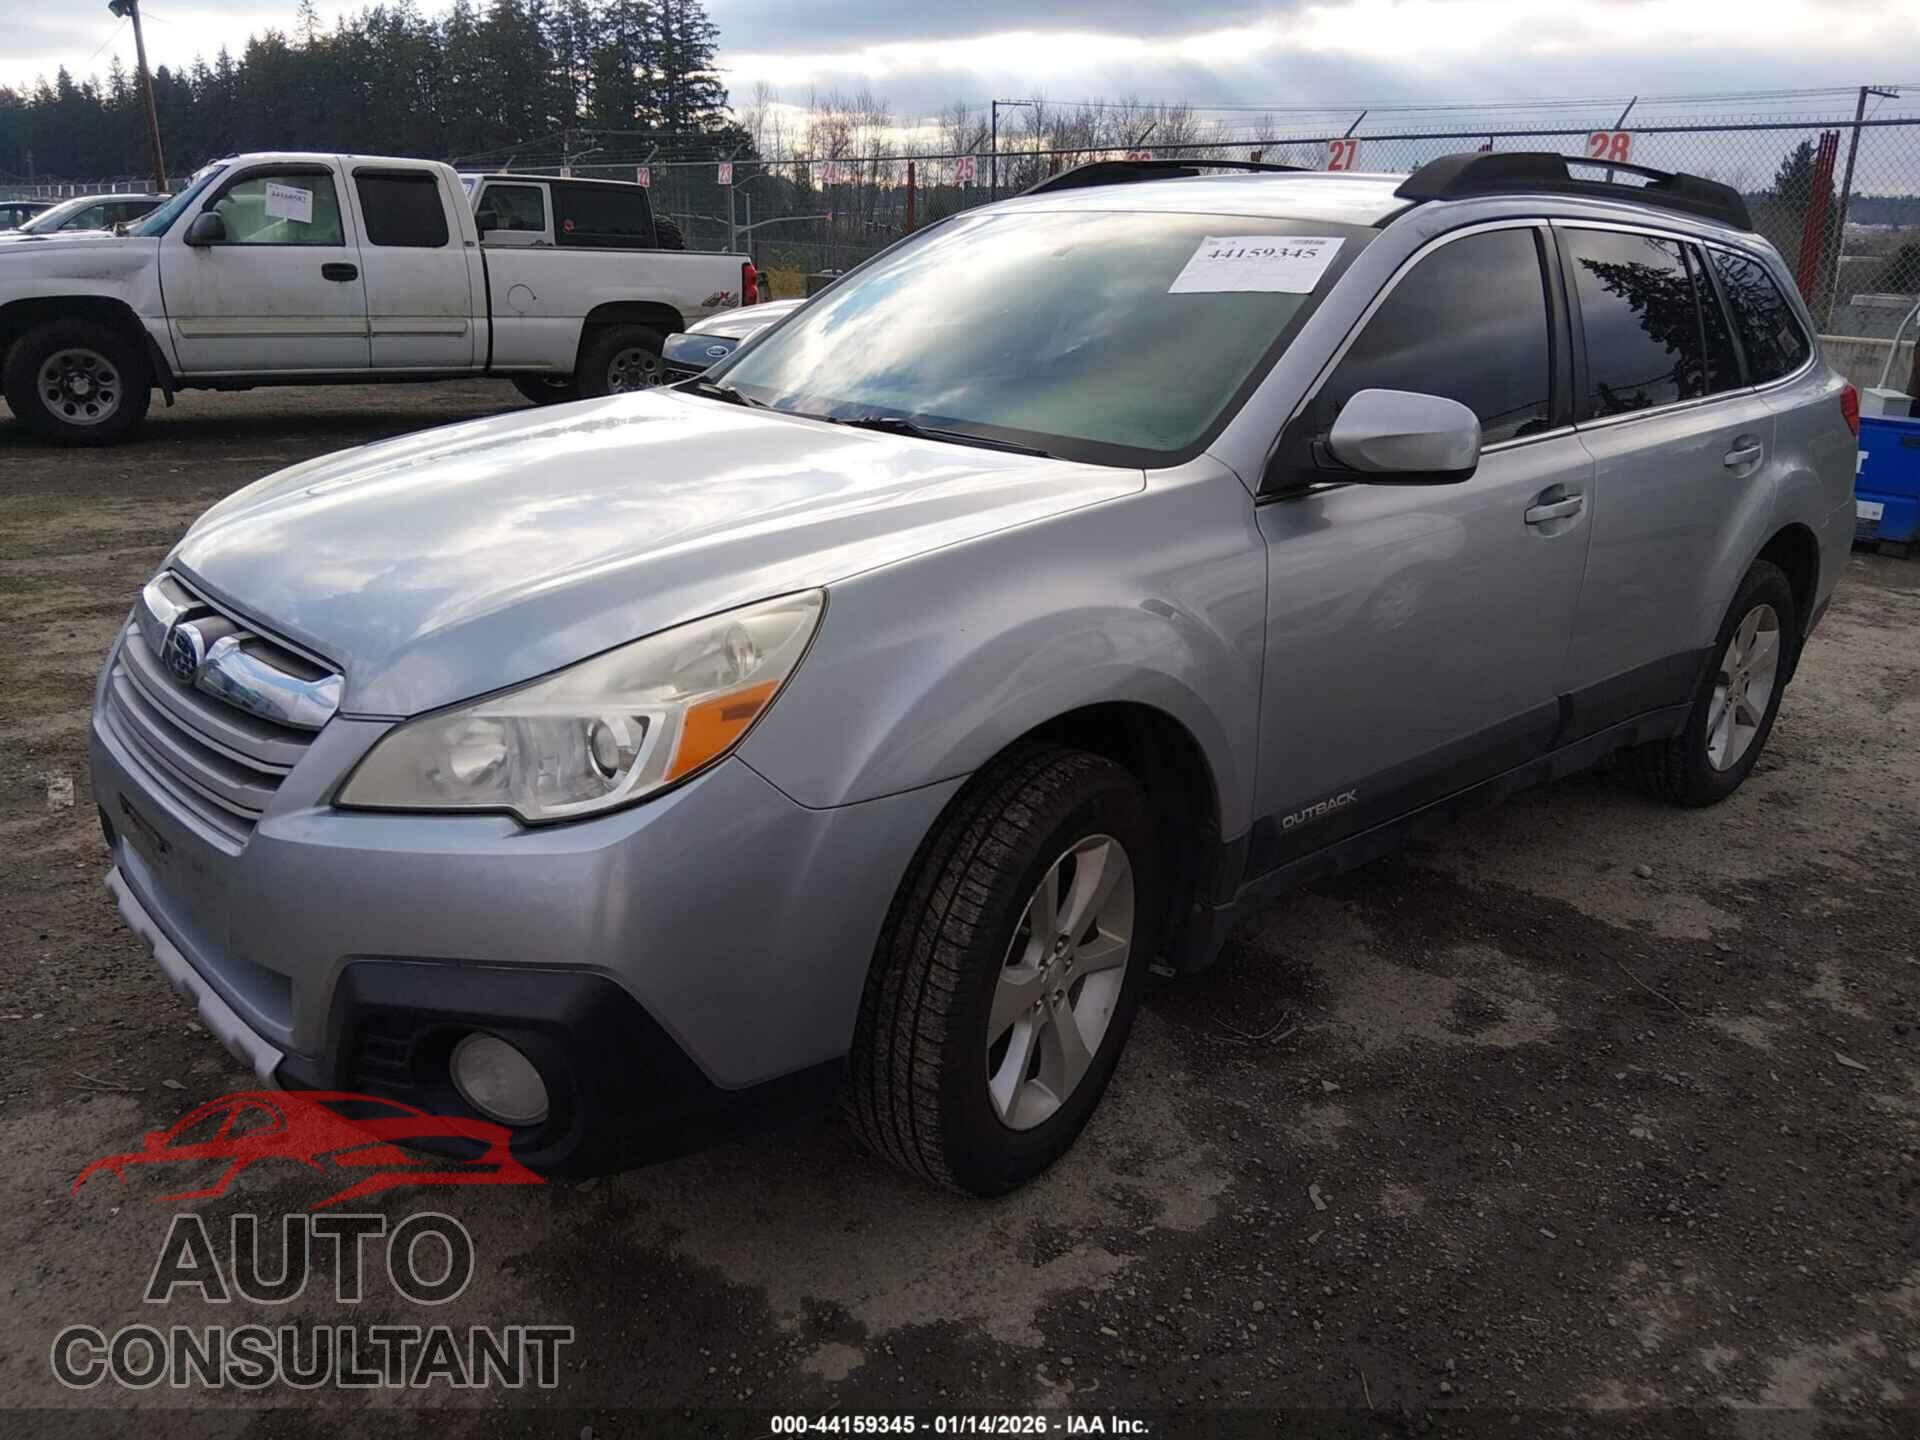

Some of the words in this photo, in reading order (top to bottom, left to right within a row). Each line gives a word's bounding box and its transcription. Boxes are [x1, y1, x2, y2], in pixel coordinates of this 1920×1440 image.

[1328, 139, 1356, 171] 27
[1589, 133, 1630, 161] 28
[822, 161, 836, 182] 24
[955, 156, 974, 181] 25
[1208, 247, 1319, 259] 44159345
[1282, 788, 1358, 829] OUTBACK
